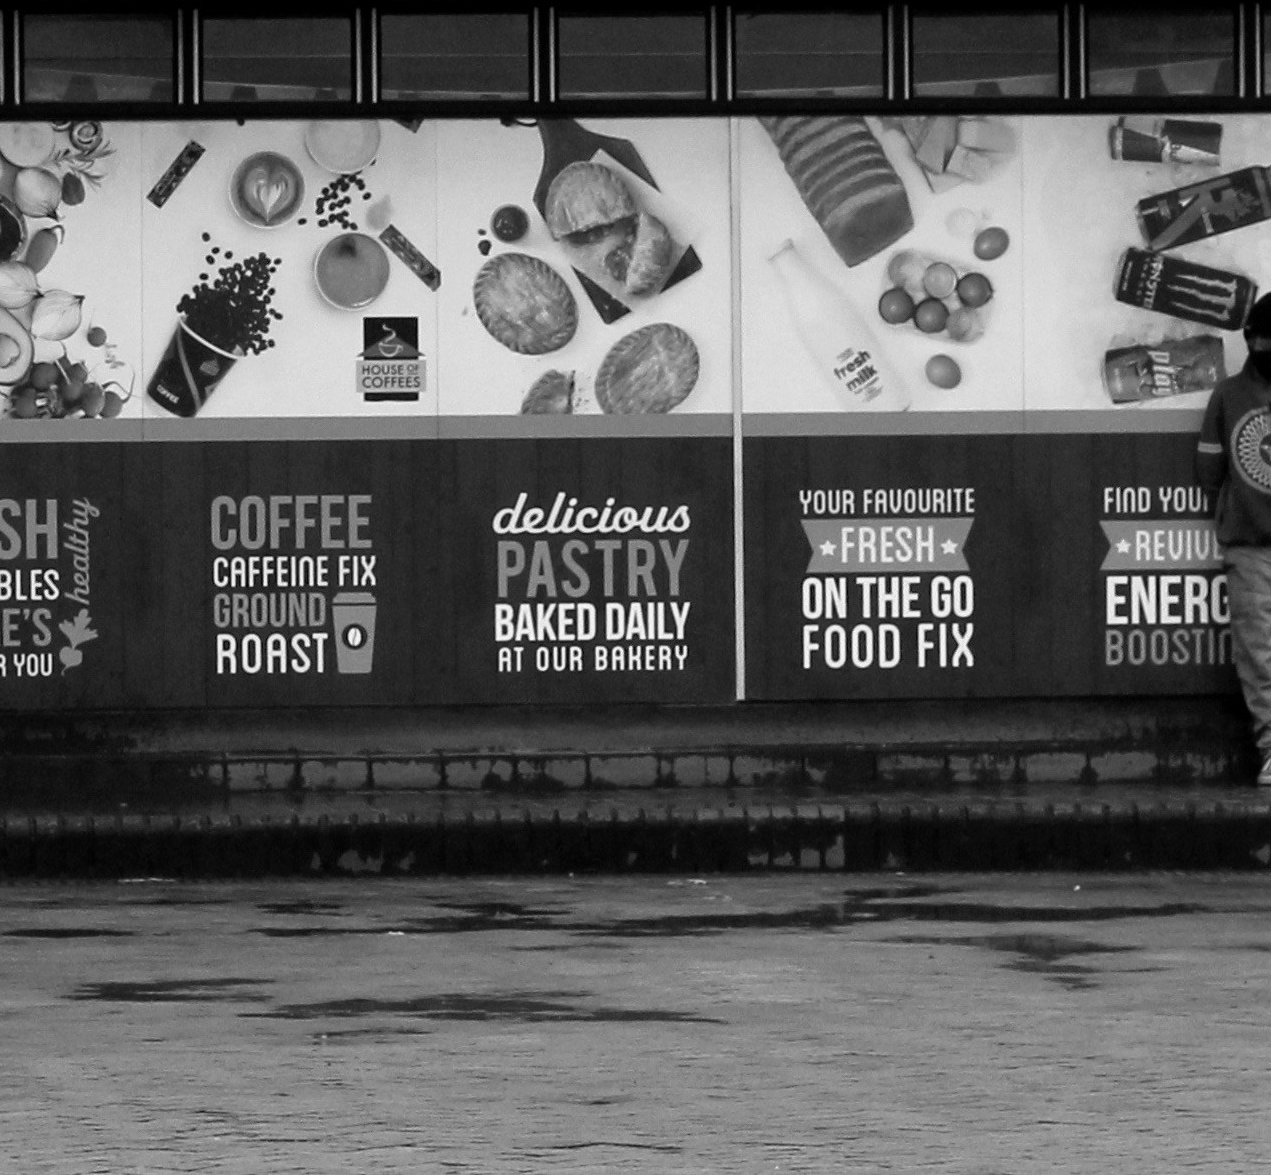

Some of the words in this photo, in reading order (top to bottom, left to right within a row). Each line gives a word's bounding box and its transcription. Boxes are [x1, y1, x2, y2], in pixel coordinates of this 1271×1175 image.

[362, 364, 405, 376] HOUSE
[406, 364, 419, 373] OF
[362, 376, 421, 389] COFFEES
[834, 350, 872, 381] fresh
[846, 365, 878, 392] milk
[492, 491, 691, 534] delicious
[799, 489, 855, 515] YOUR
[863, 487, 975, 515] FAVOURITE
[1103, 486, 1151, 514] FIND
[210, 494, 373, 551] COFFEE
[60, 495, 103, 604] healthy
[840, 527, 933, 564] FRESH
[213, 555, 329, 588] CAFFEINE
[338, 555, 377, 587] FIX
[497, 538, 690, 599] PASTRY
[213, 592, 327, 629] GROUND
[802, 577, 847, 620] ON
[855, 576, 921, 619] THE
[930, 575, 974, 618] GO
[1104, 573, 1232, 626] ENERG
[494, 602, 597, 642] BAKED
[605, 601, 691, 641] DAILY
[216, 632, 329, 674] ROAST
[498, 646, 525, 673] AT
[536, 645, 583, 672] OUR
[594, 644, 688, 671] BAKERY
[803, 623, 901, 669] FOOD
[917, 622, 974, 668] FIX
[13, 652, 53, 677] YOU
